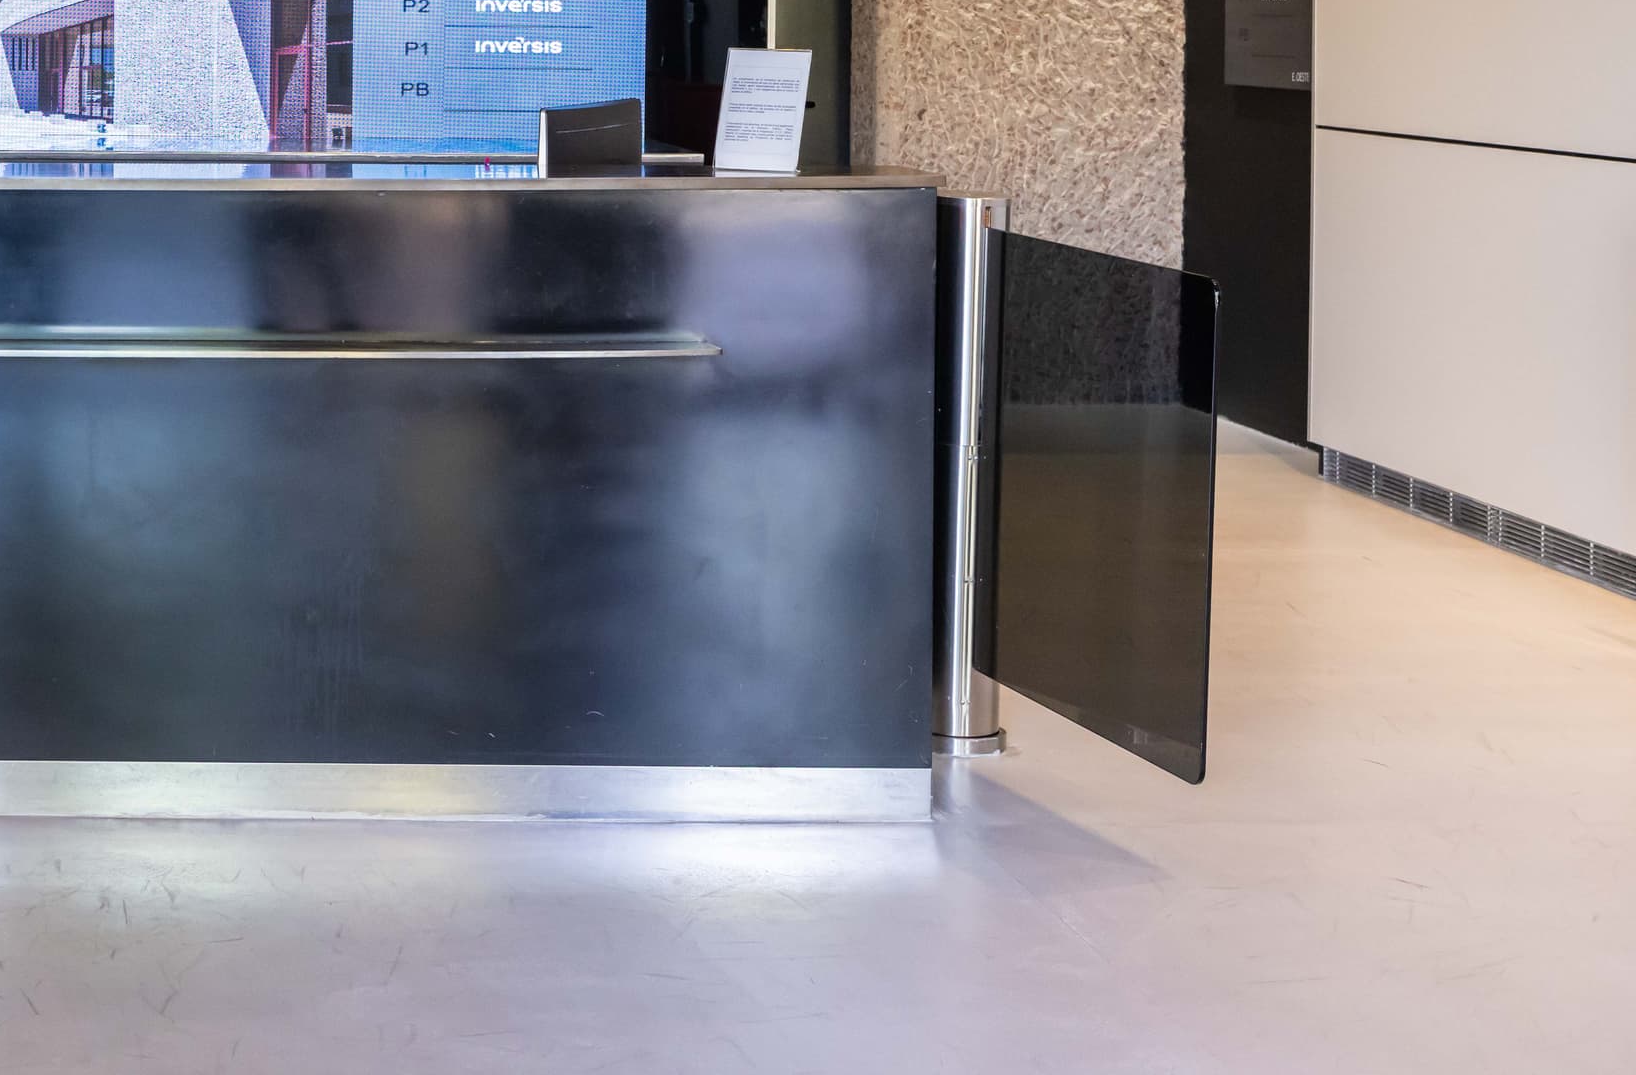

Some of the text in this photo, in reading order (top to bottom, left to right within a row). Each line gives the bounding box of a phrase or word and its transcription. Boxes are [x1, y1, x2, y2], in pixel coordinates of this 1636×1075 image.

[402, 0, 430, 13] P2
[404, 37, 562, 56] P1 inversis
[400, 82, 430, 97] PB
